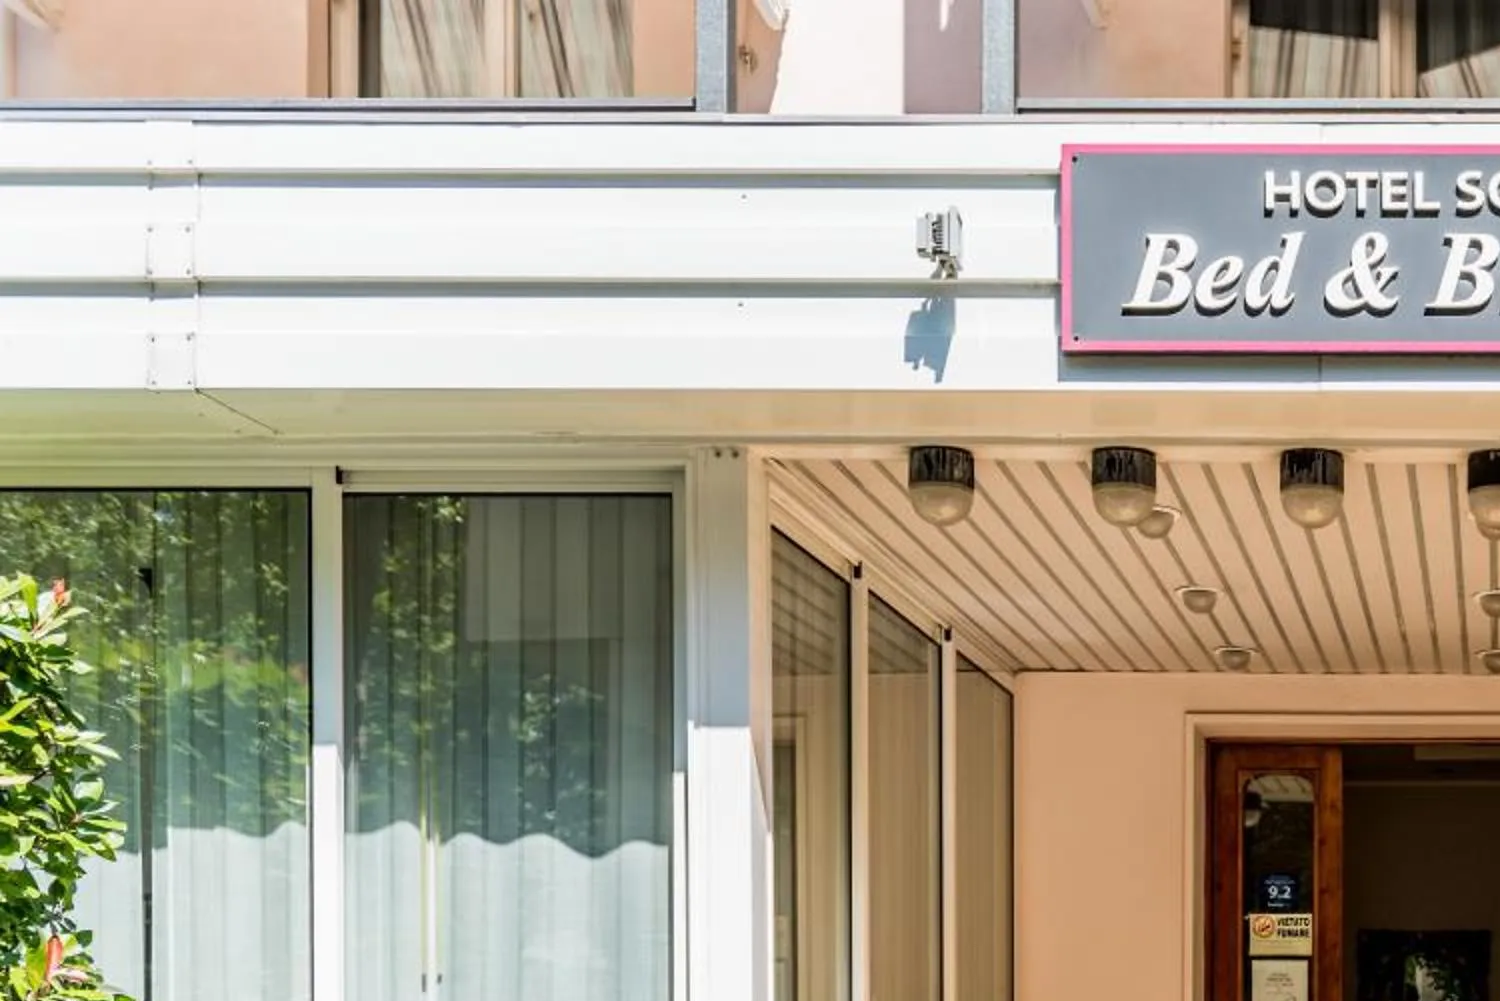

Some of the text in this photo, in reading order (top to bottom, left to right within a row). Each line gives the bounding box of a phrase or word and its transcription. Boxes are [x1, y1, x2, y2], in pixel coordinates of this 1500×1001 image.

[1263, 170, 1440, 217] HOTEL
[1121, 231, 1306, 317] Bed
[1319, 231, 1398, 317] &
